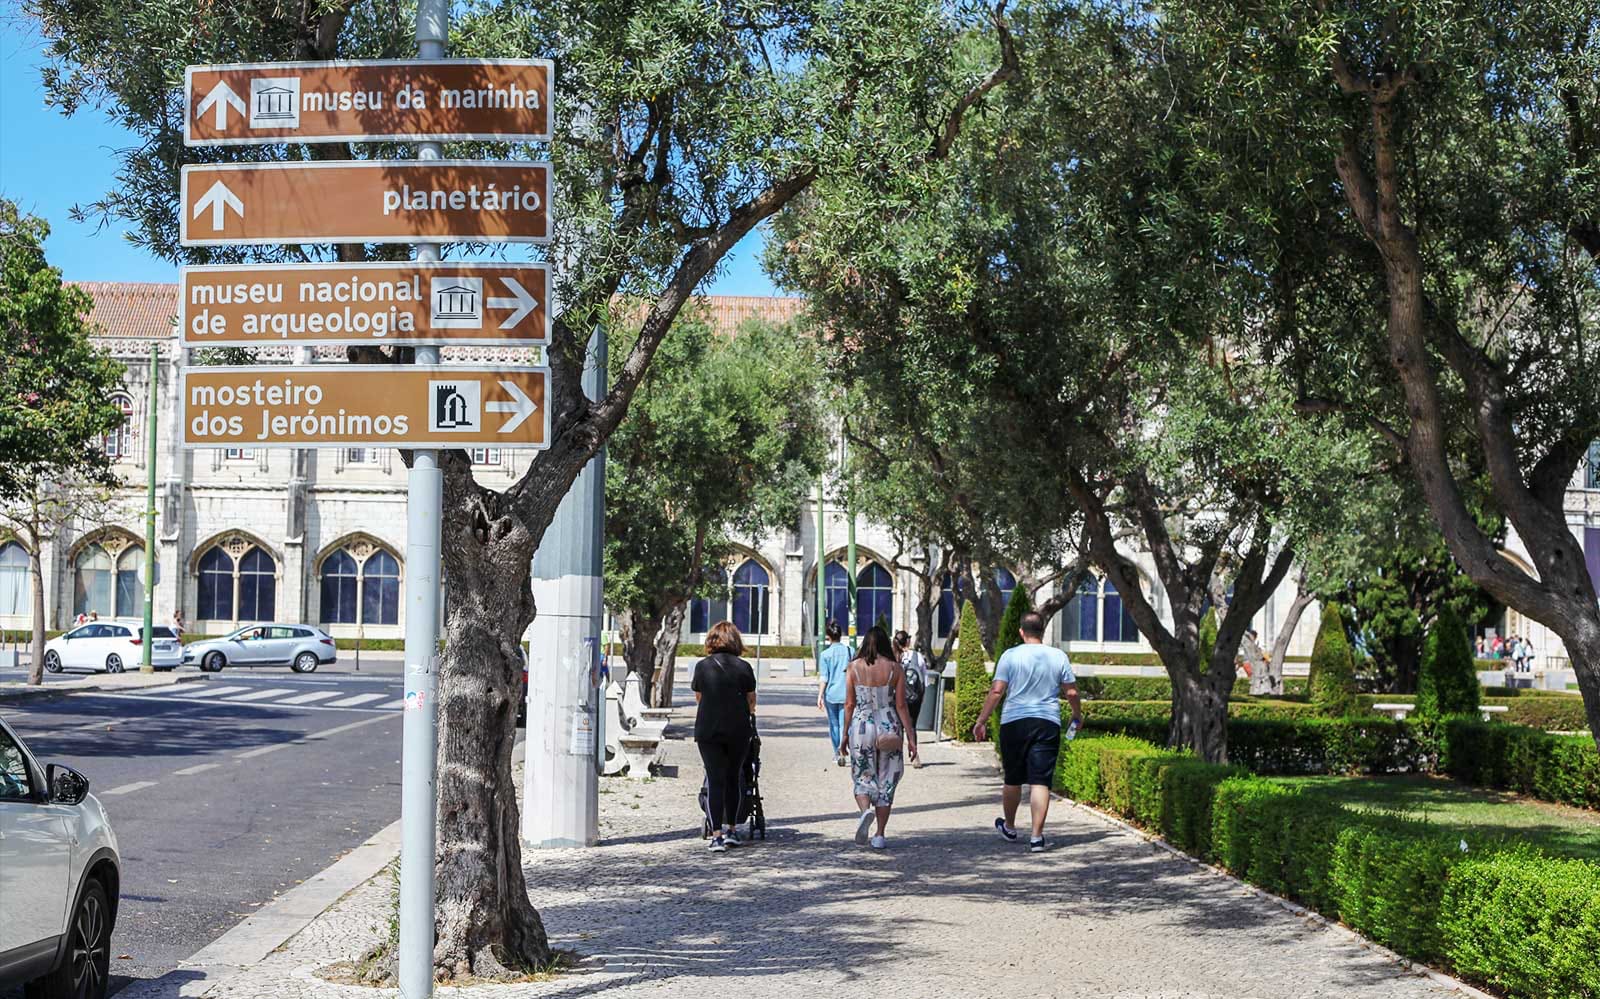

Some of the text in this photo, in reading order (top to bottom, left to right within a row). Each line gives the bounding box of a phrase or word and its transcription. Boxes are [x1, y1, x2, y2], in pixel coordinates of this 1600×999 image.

[303, 85, 539, 112] museu da marinha
[384, 183, 541, 215] planetário
[192, 276, 422, 304] museu nacional
[192, 306, 415, 338] de arqueologia
[192, 380, 322, 405] mosteiro
[192, 409, 408, 440] dos Jerónimos
